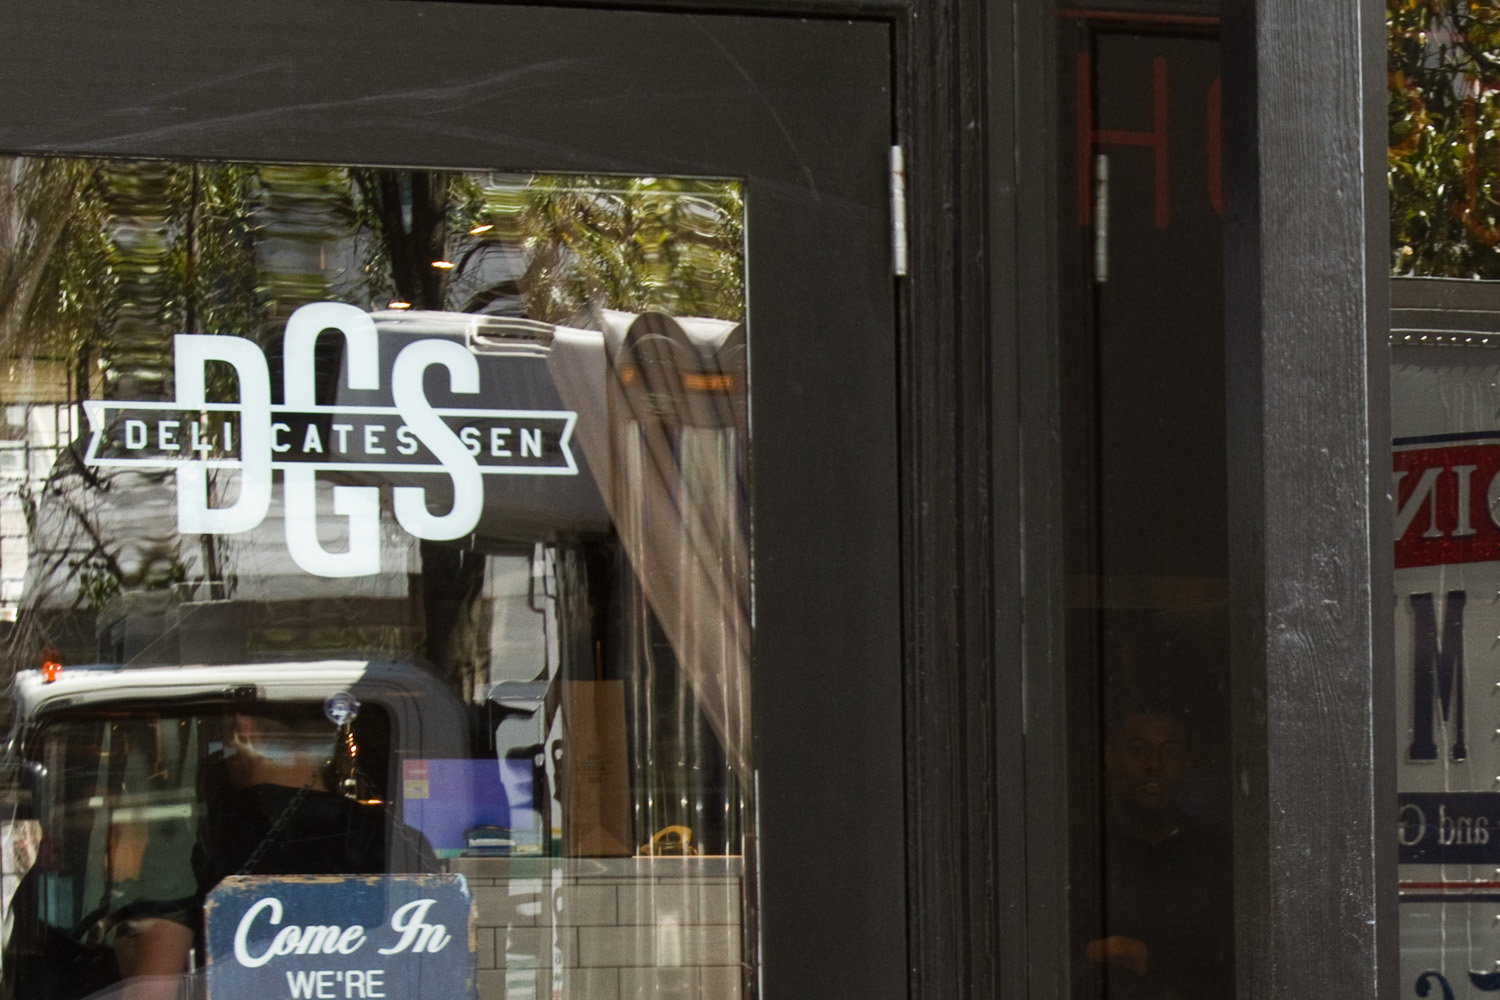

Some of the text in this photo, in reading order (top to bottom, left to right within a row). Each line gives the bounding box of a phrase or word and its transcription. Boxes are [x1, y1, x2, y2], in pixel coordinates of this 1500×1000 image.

[125, 419, 543, 459] DELICATESSEN
[174, 301, 485, 578] DGS
[233, 896, 453, 969] Come In
[285, 969, 387, 1000] WE'RE
